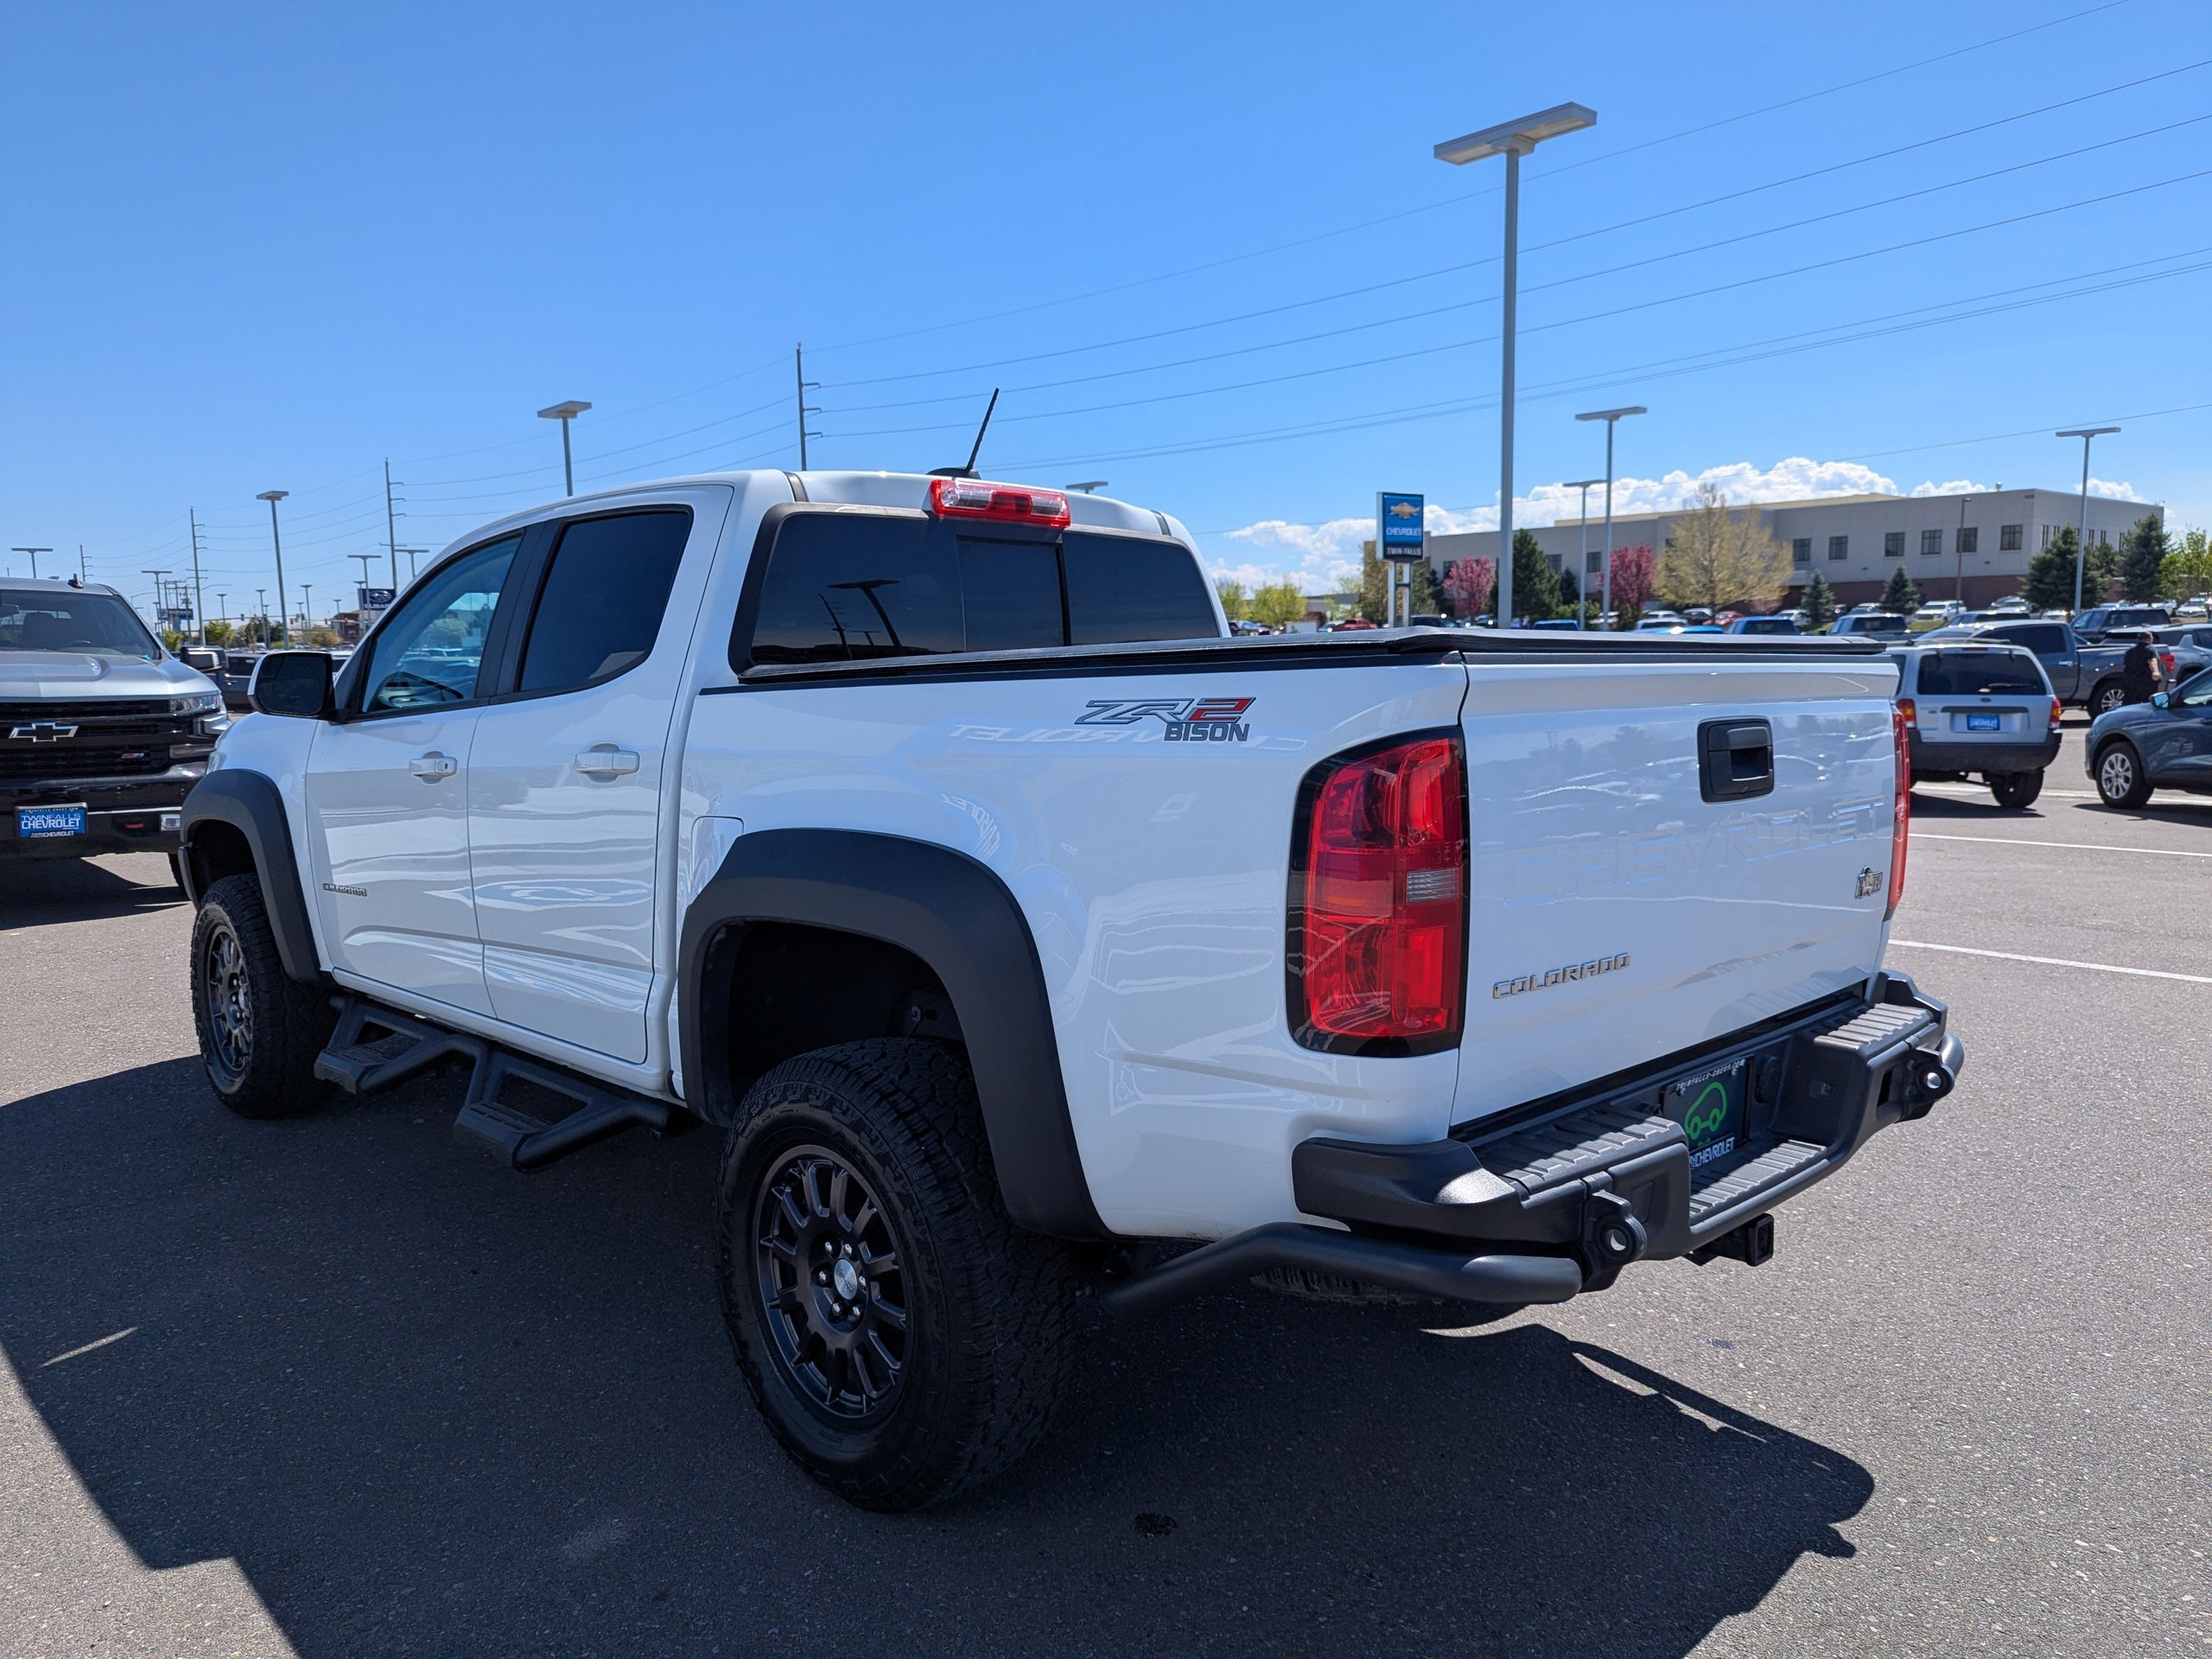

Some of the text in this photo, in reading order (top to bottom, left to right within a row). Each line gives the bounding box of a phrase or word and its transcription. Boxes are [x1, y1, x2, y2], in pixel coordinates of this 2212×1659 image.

[1386, 527, 1421, 536] CHEVROLET
[1403, 547, 1421, 556] FALLS
[1074, 696, 1256, 724] ZR2
[1164, 723, 1250, 741] BISON
[22, 818, 81, 830] CHEVROLET
[1503, 794, 1885, 906] CHEVROLET
[1493, 952, 1631, 999] COLORADO
[1694, 1136, 1735, 1167] CHEVROLET
